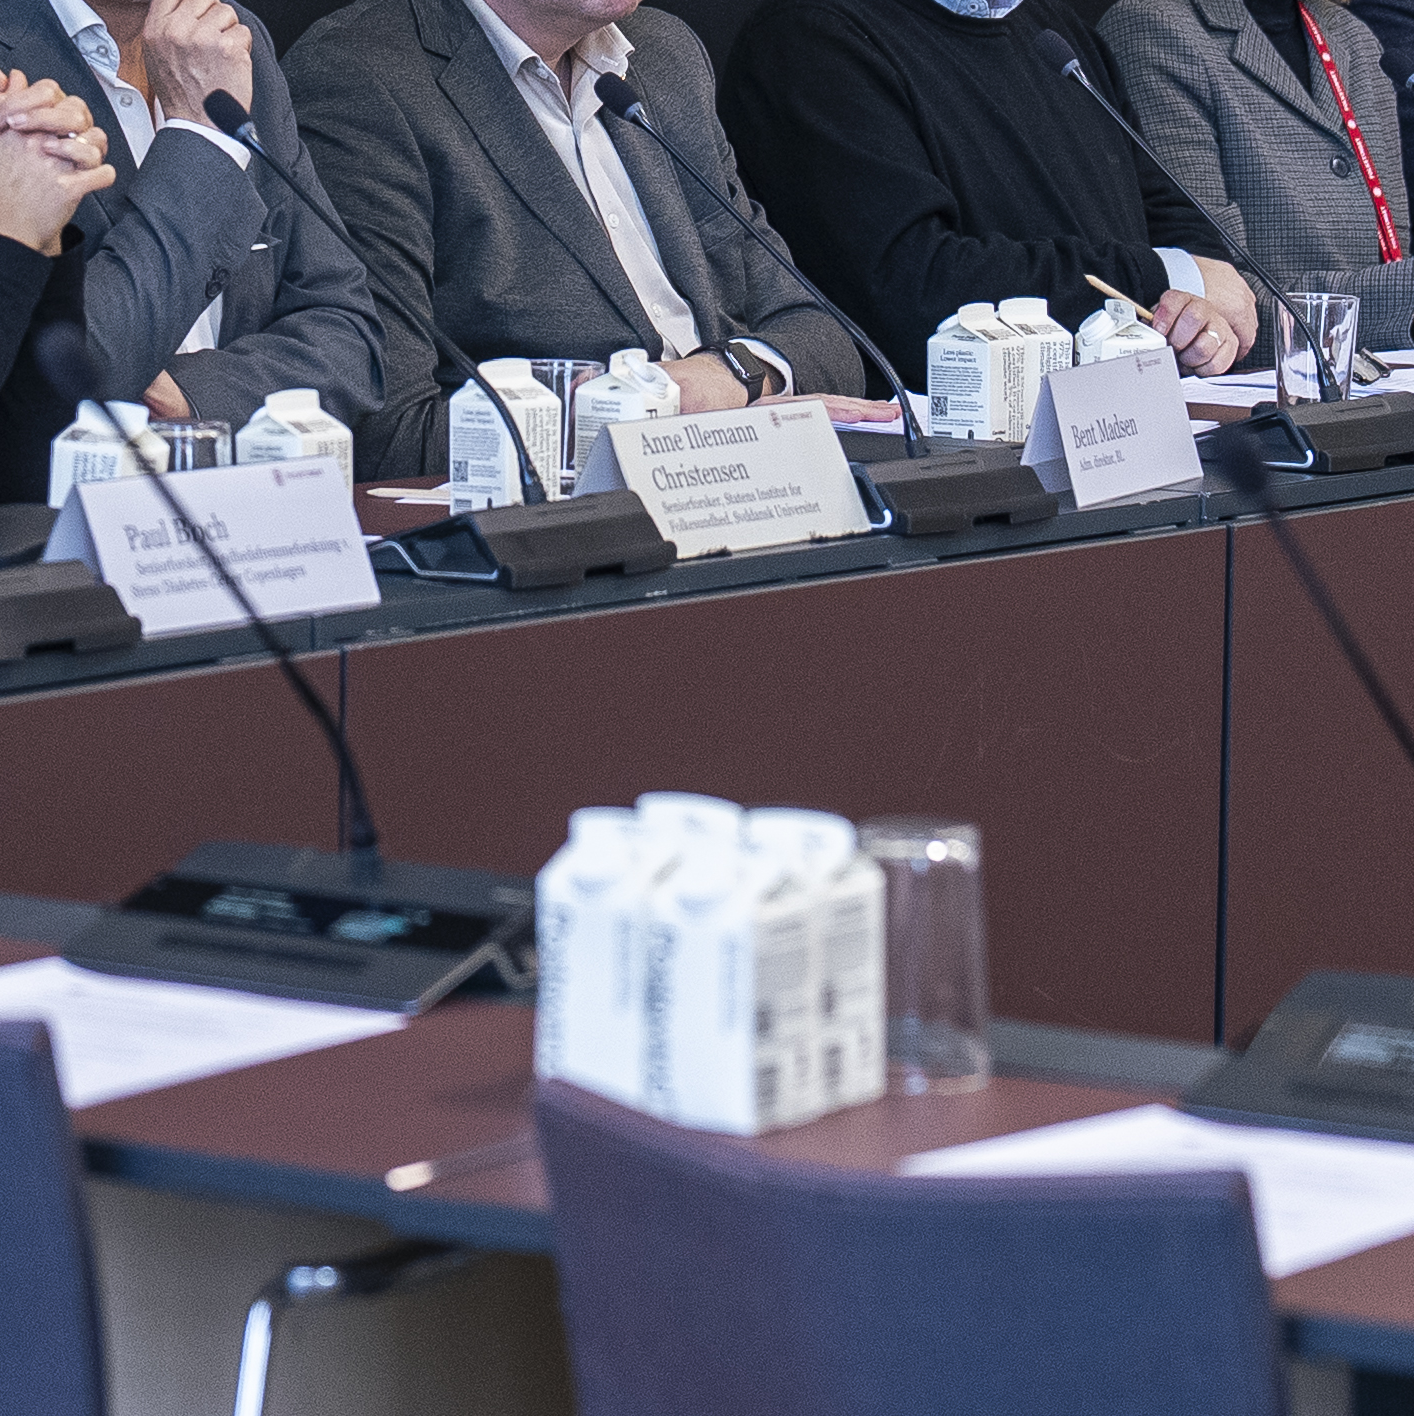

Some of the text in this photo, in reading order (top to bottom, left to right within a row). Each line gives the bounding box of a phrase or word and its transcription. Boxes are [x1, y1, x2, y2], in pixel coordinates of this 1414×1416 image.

[641, 432, 685, 456] Anne
[683, 423, 759, 450] Illemann
[1071, 413, 1138, 449] Bent Madsen
[651, 462, 751, 492] Christensen
[122, 512, 230, 553] Paul Boch
